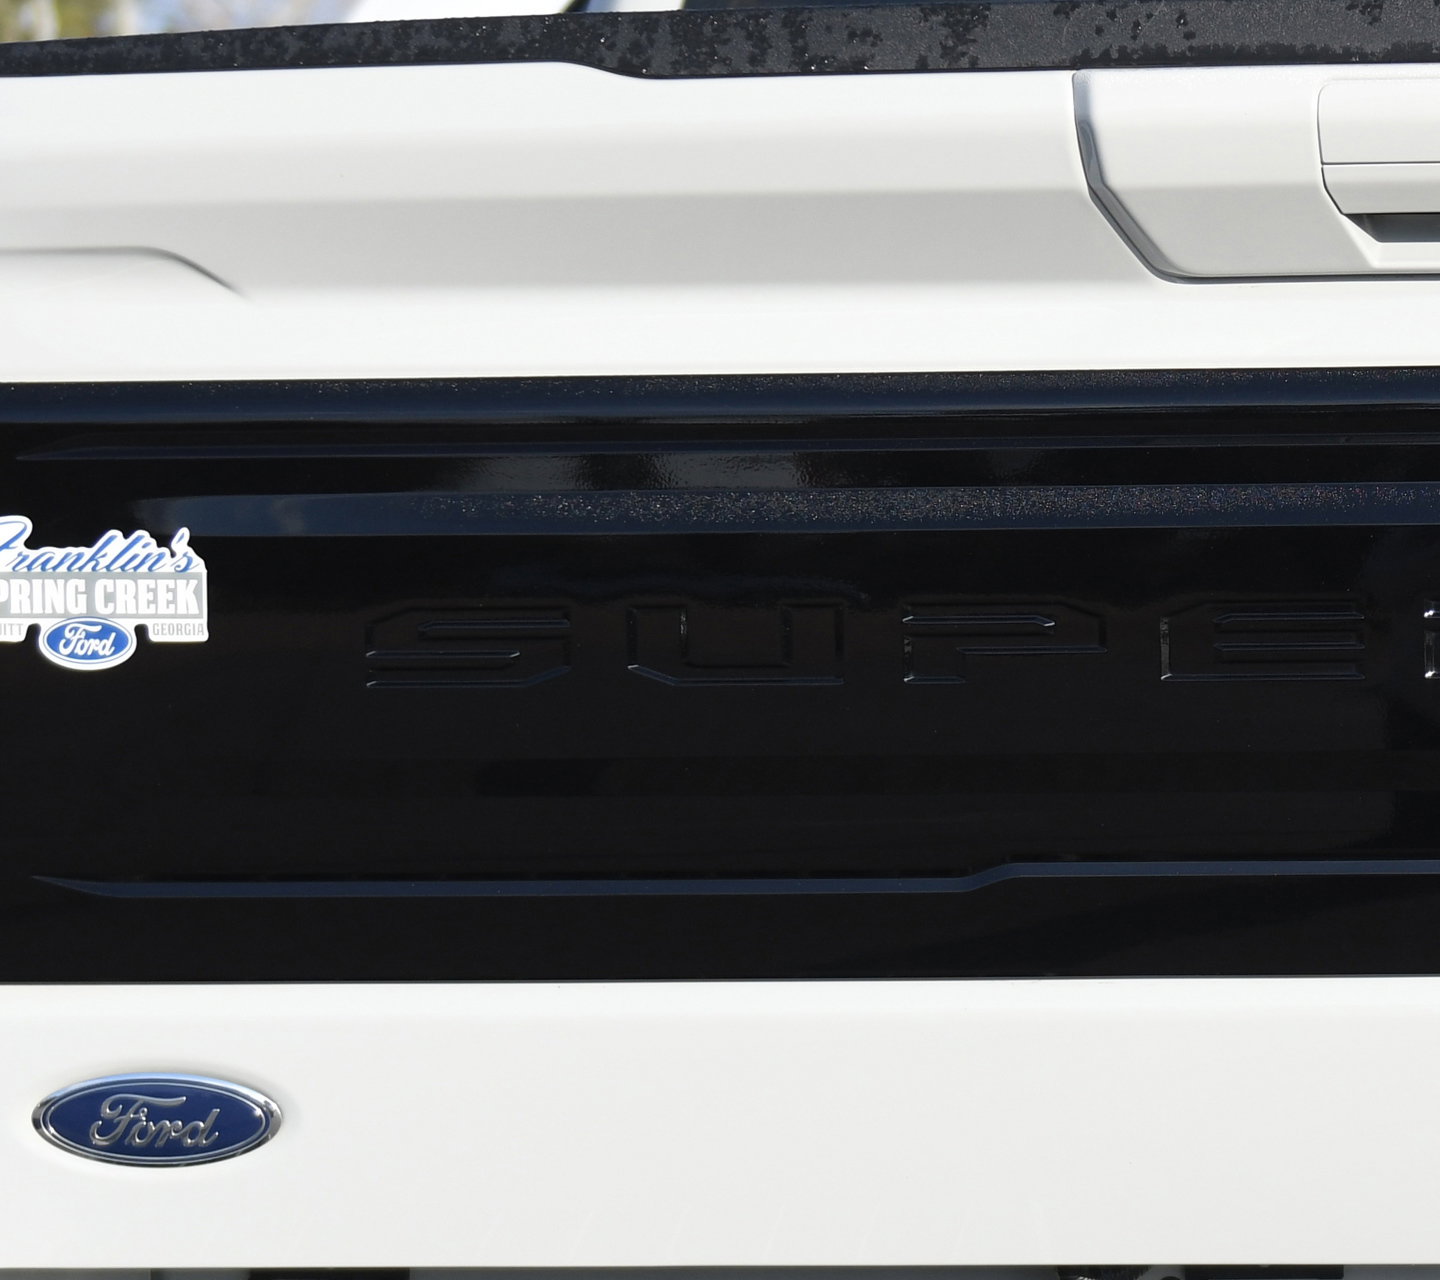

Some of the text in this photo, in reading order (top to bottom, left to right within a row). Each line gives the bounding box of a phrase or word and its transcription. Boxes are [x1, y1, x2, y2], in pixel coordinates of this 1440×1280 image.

[94, 578, 199, 615] CREEK
[59, 623, 116, 656] Ford
[152, 622, 205, 636] GEORGIA
[89, 1092, 222, 1148] Ford
